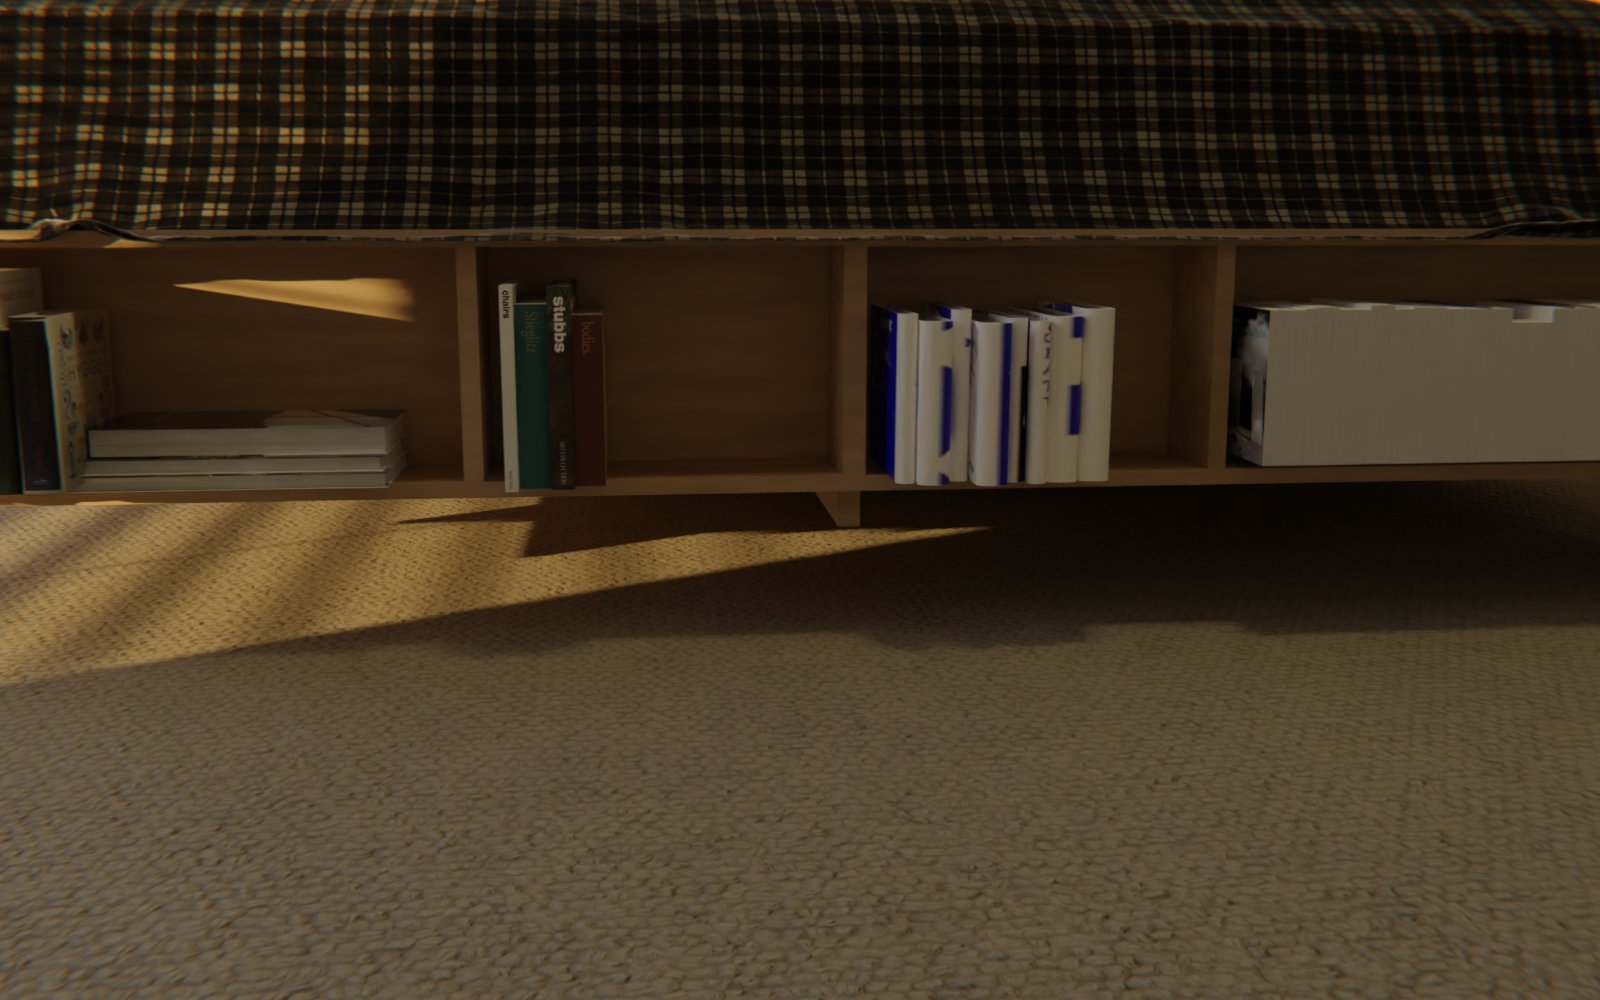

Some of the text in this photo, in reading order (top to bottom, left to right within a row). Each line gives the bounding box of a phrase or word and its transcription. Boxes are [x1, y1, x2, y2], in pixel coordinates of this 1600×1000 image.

[501, 290, 510, 319] chairs
[552, 296, 568, 354] stubbs
[521, 311, 540, 353] Stieglitz
